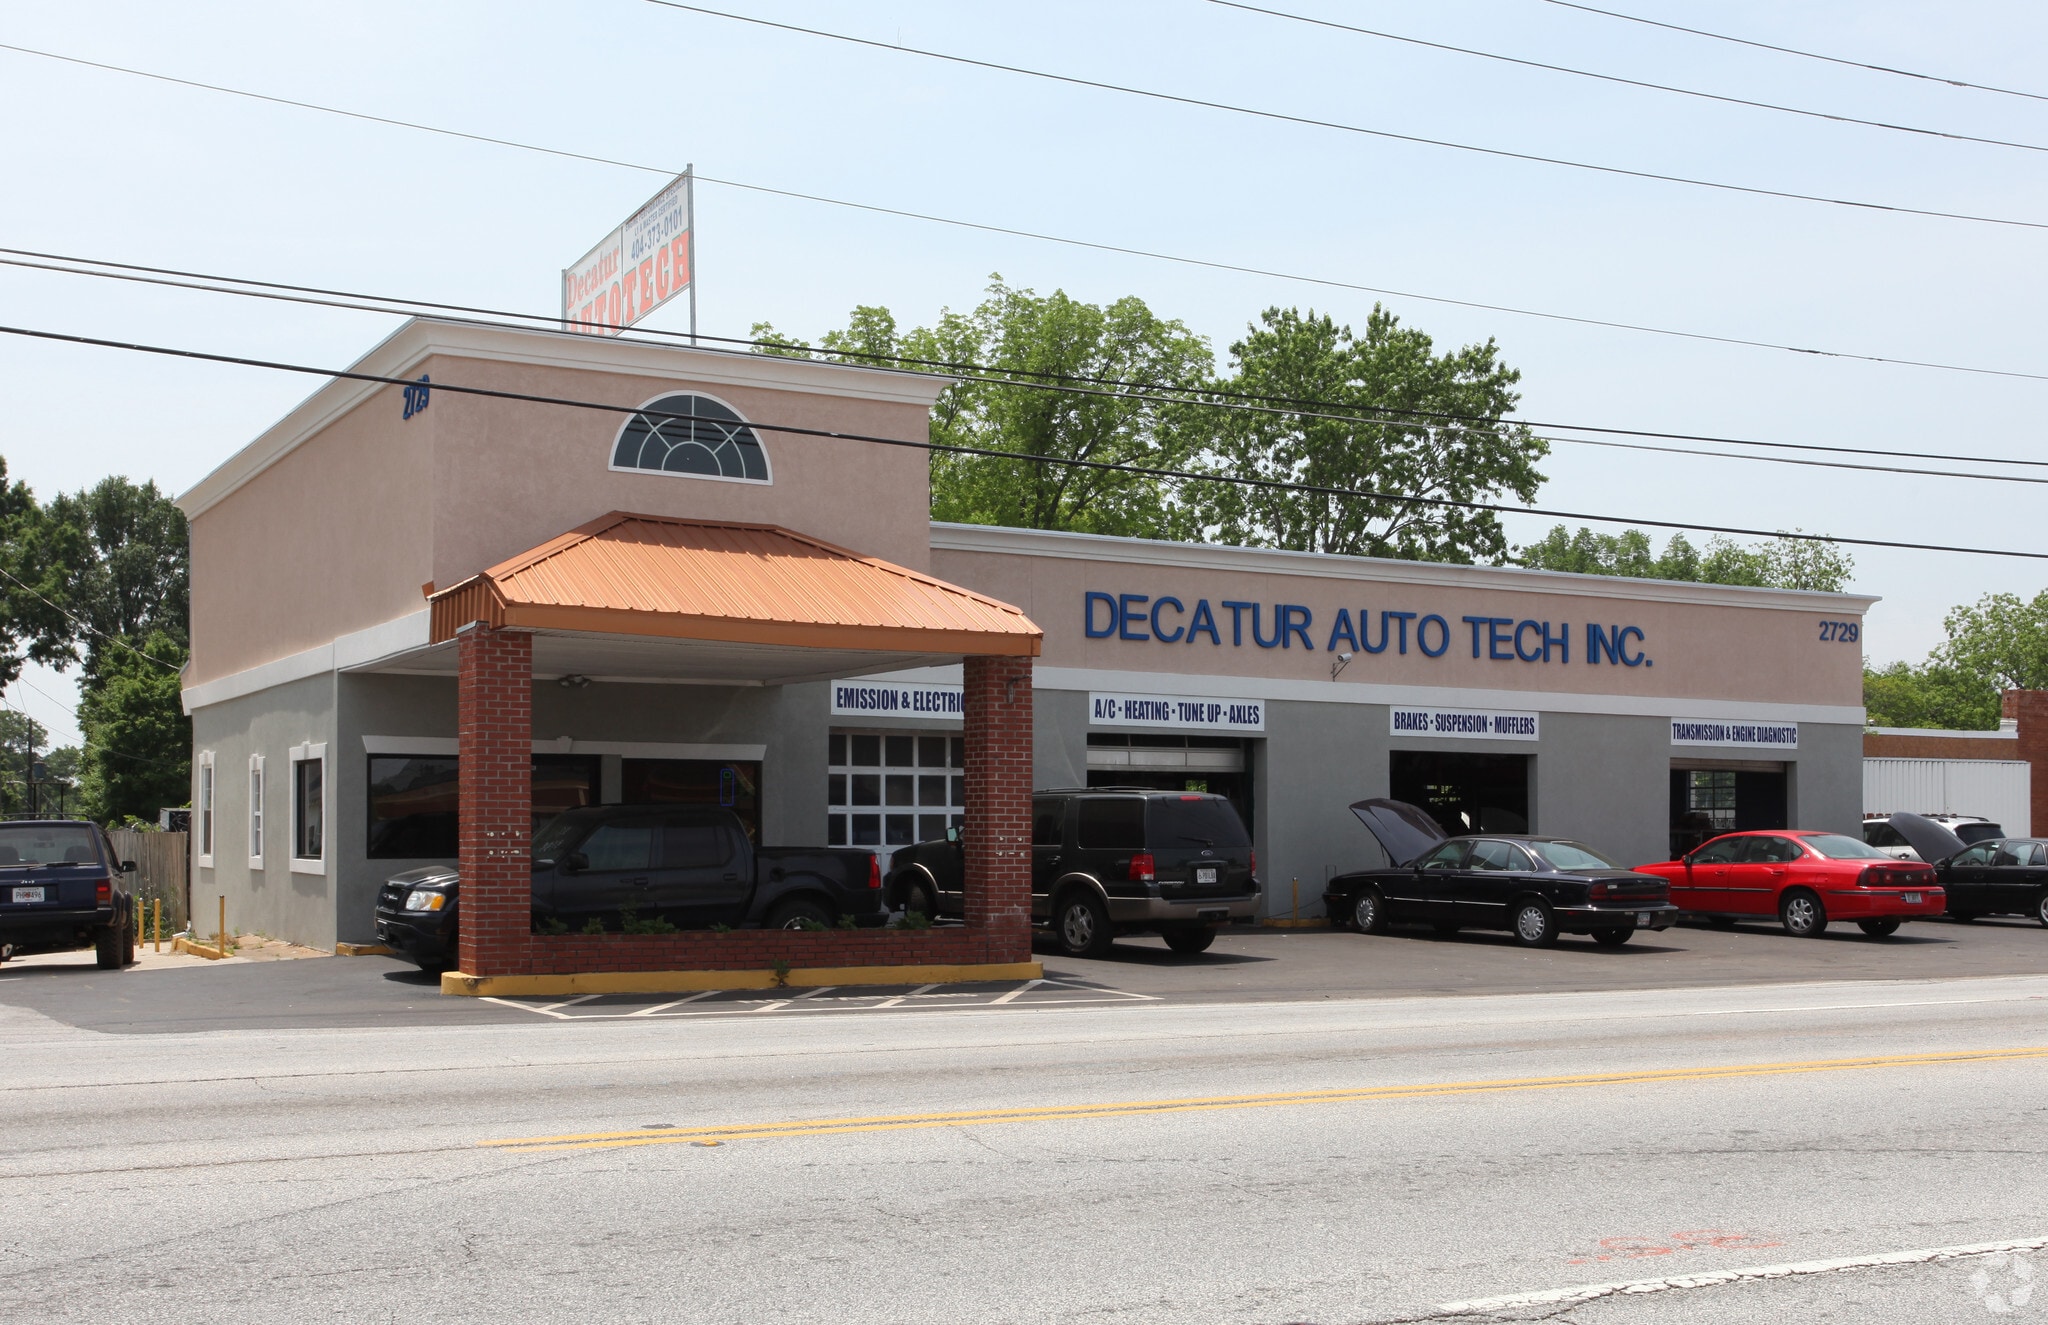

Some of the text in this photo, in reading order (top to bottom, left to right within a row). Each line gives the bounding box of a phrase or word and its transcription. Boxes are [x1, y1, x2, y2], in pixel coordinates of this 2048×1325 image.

[631, 205, 682, 261] 404-373-0101
[567, 247, 619, 310] Decatur
[1085, 591, 1653, 667] DECATUR AUTO TECH INC.
[1819, 620, 1859, 643] 2729
[836, 687, 898, 711] EMISSION
[901, 691, 910, 709] &
[1094, 698, 1260, 724] A/C HEATING TUNE UP AXLES
[1394, 711, 1535, 735] BRAKES SUSPENSION MUFFLERS
[1672, 723, 1797, 743] TRANSMISSION & ENGINE DIAGNOSTIC
